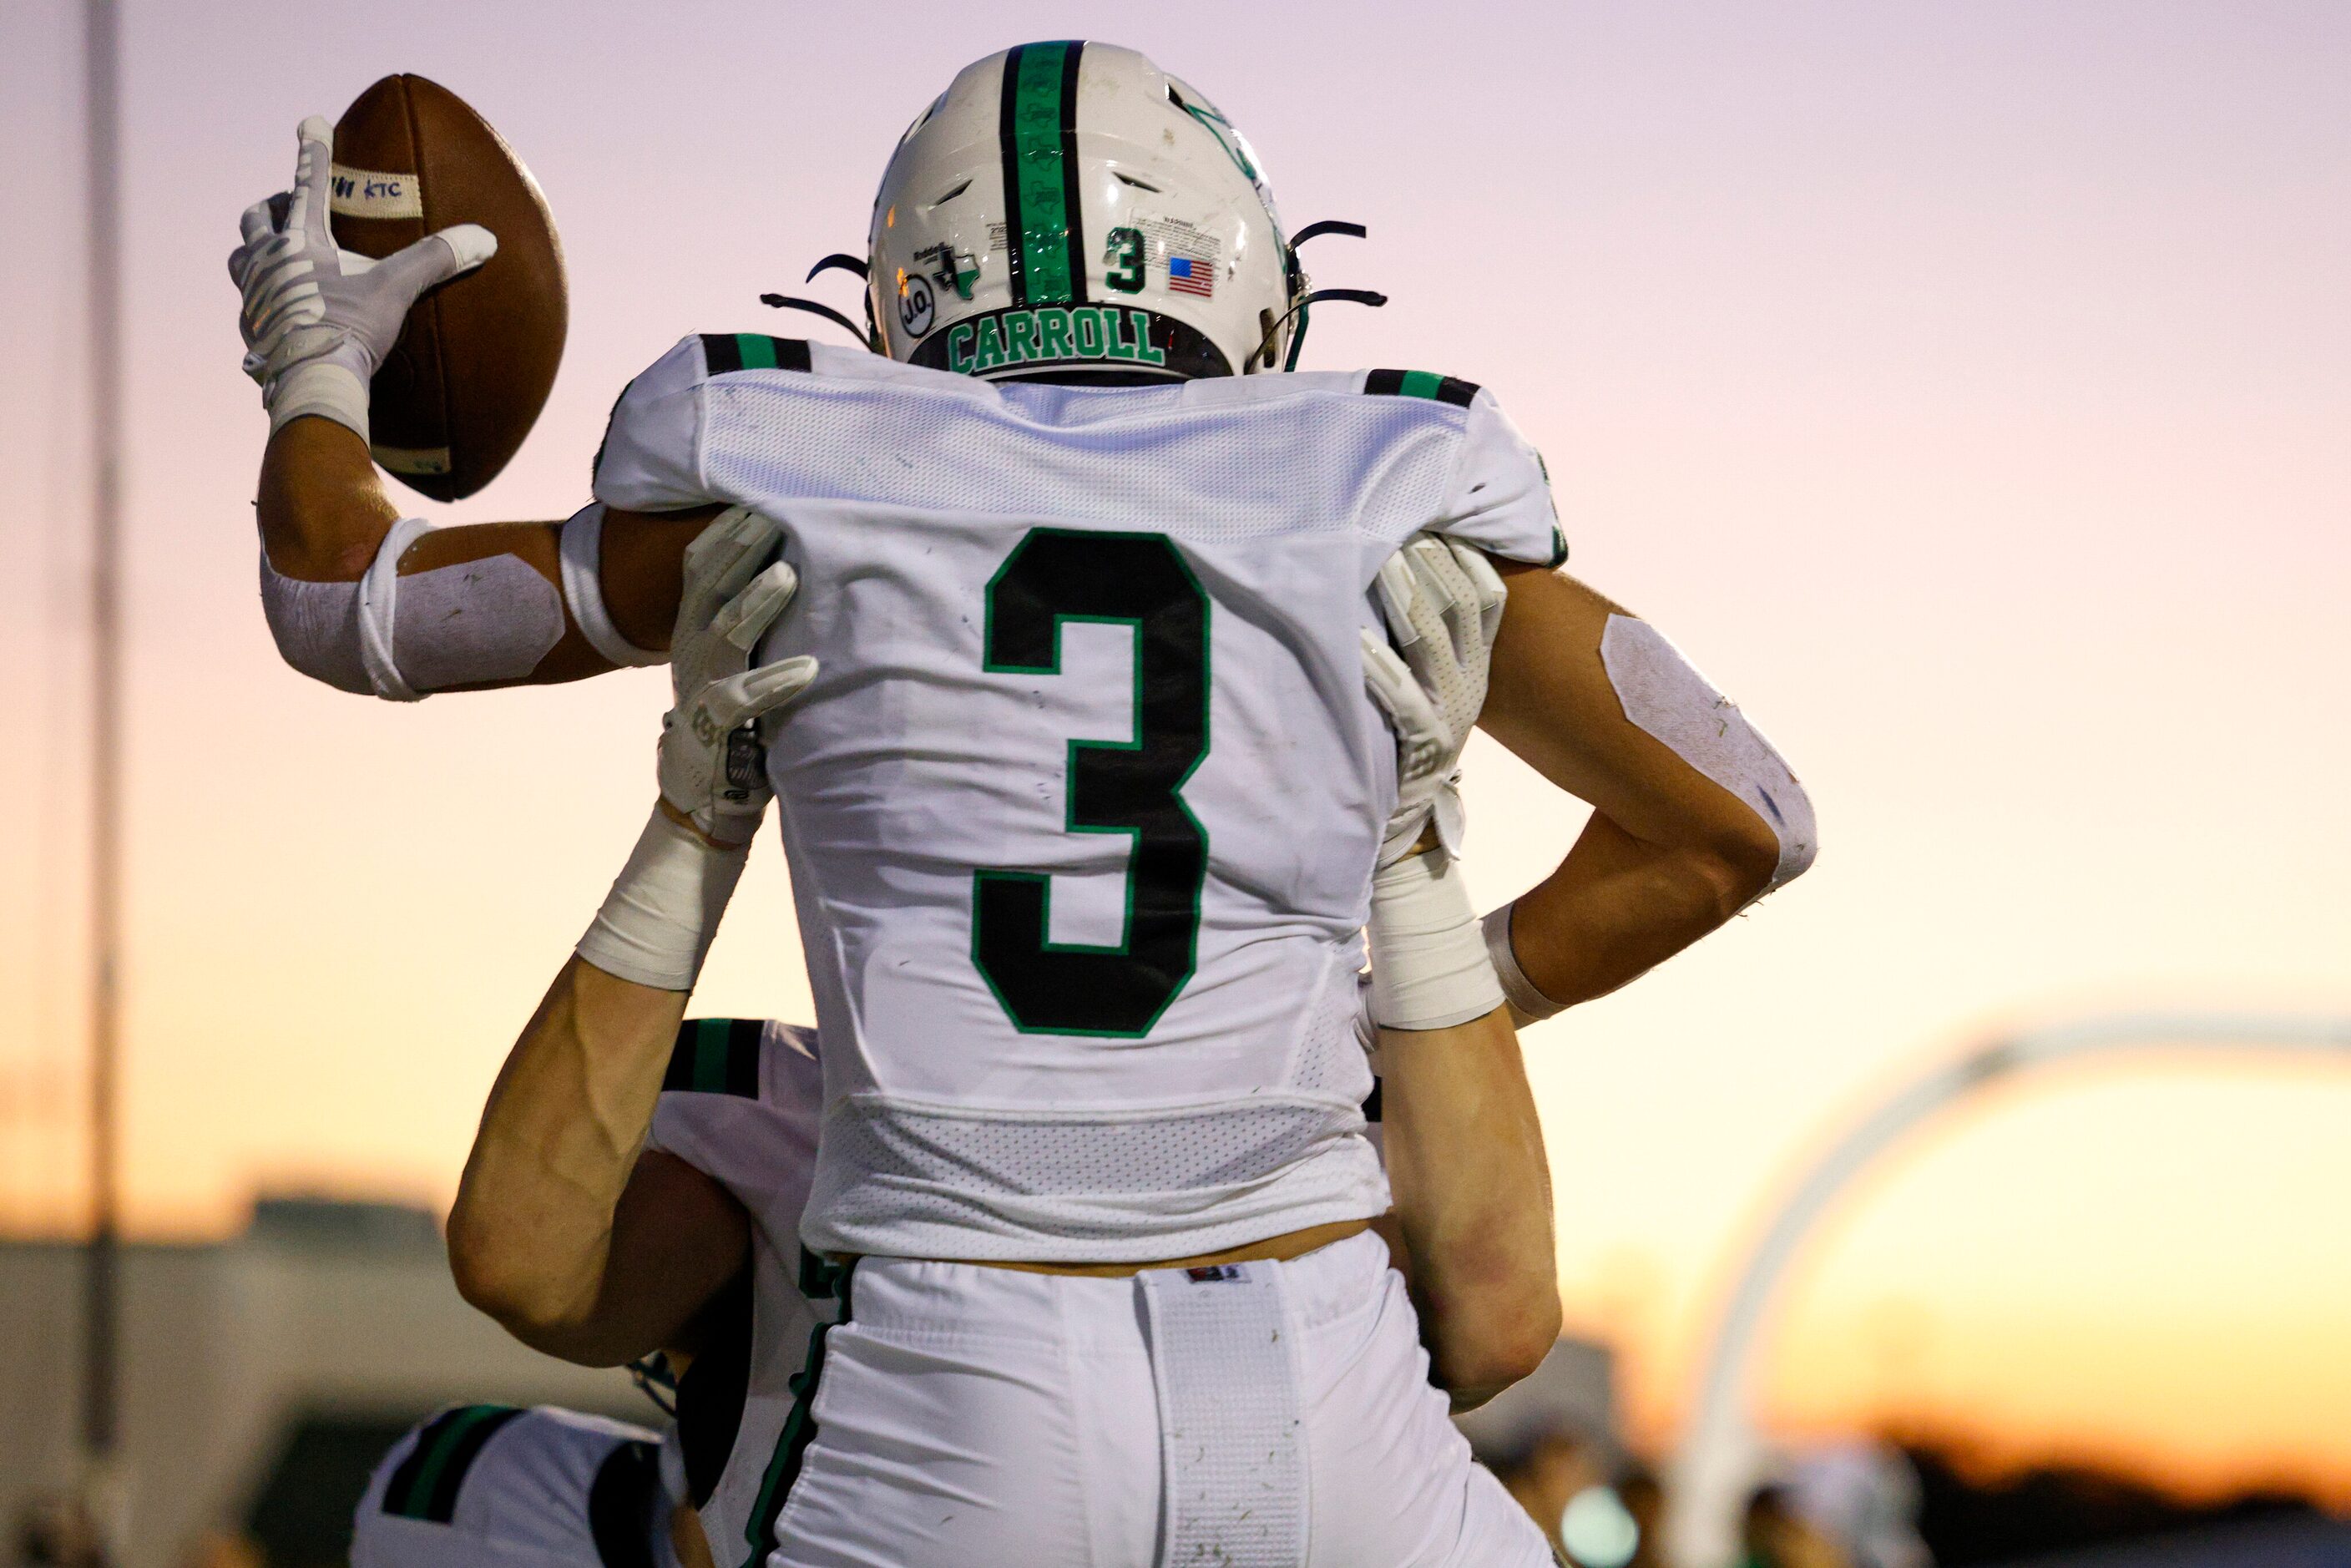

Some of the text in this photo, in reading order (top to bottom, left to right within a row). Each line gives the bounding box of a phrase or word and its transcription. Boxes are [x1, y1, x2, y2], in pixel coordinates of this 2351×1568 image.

[1105, 226, 1146, 295] 3
[947, 307, 1166, 375] CARROLL
[971, 527, 1211, 1039] 3
